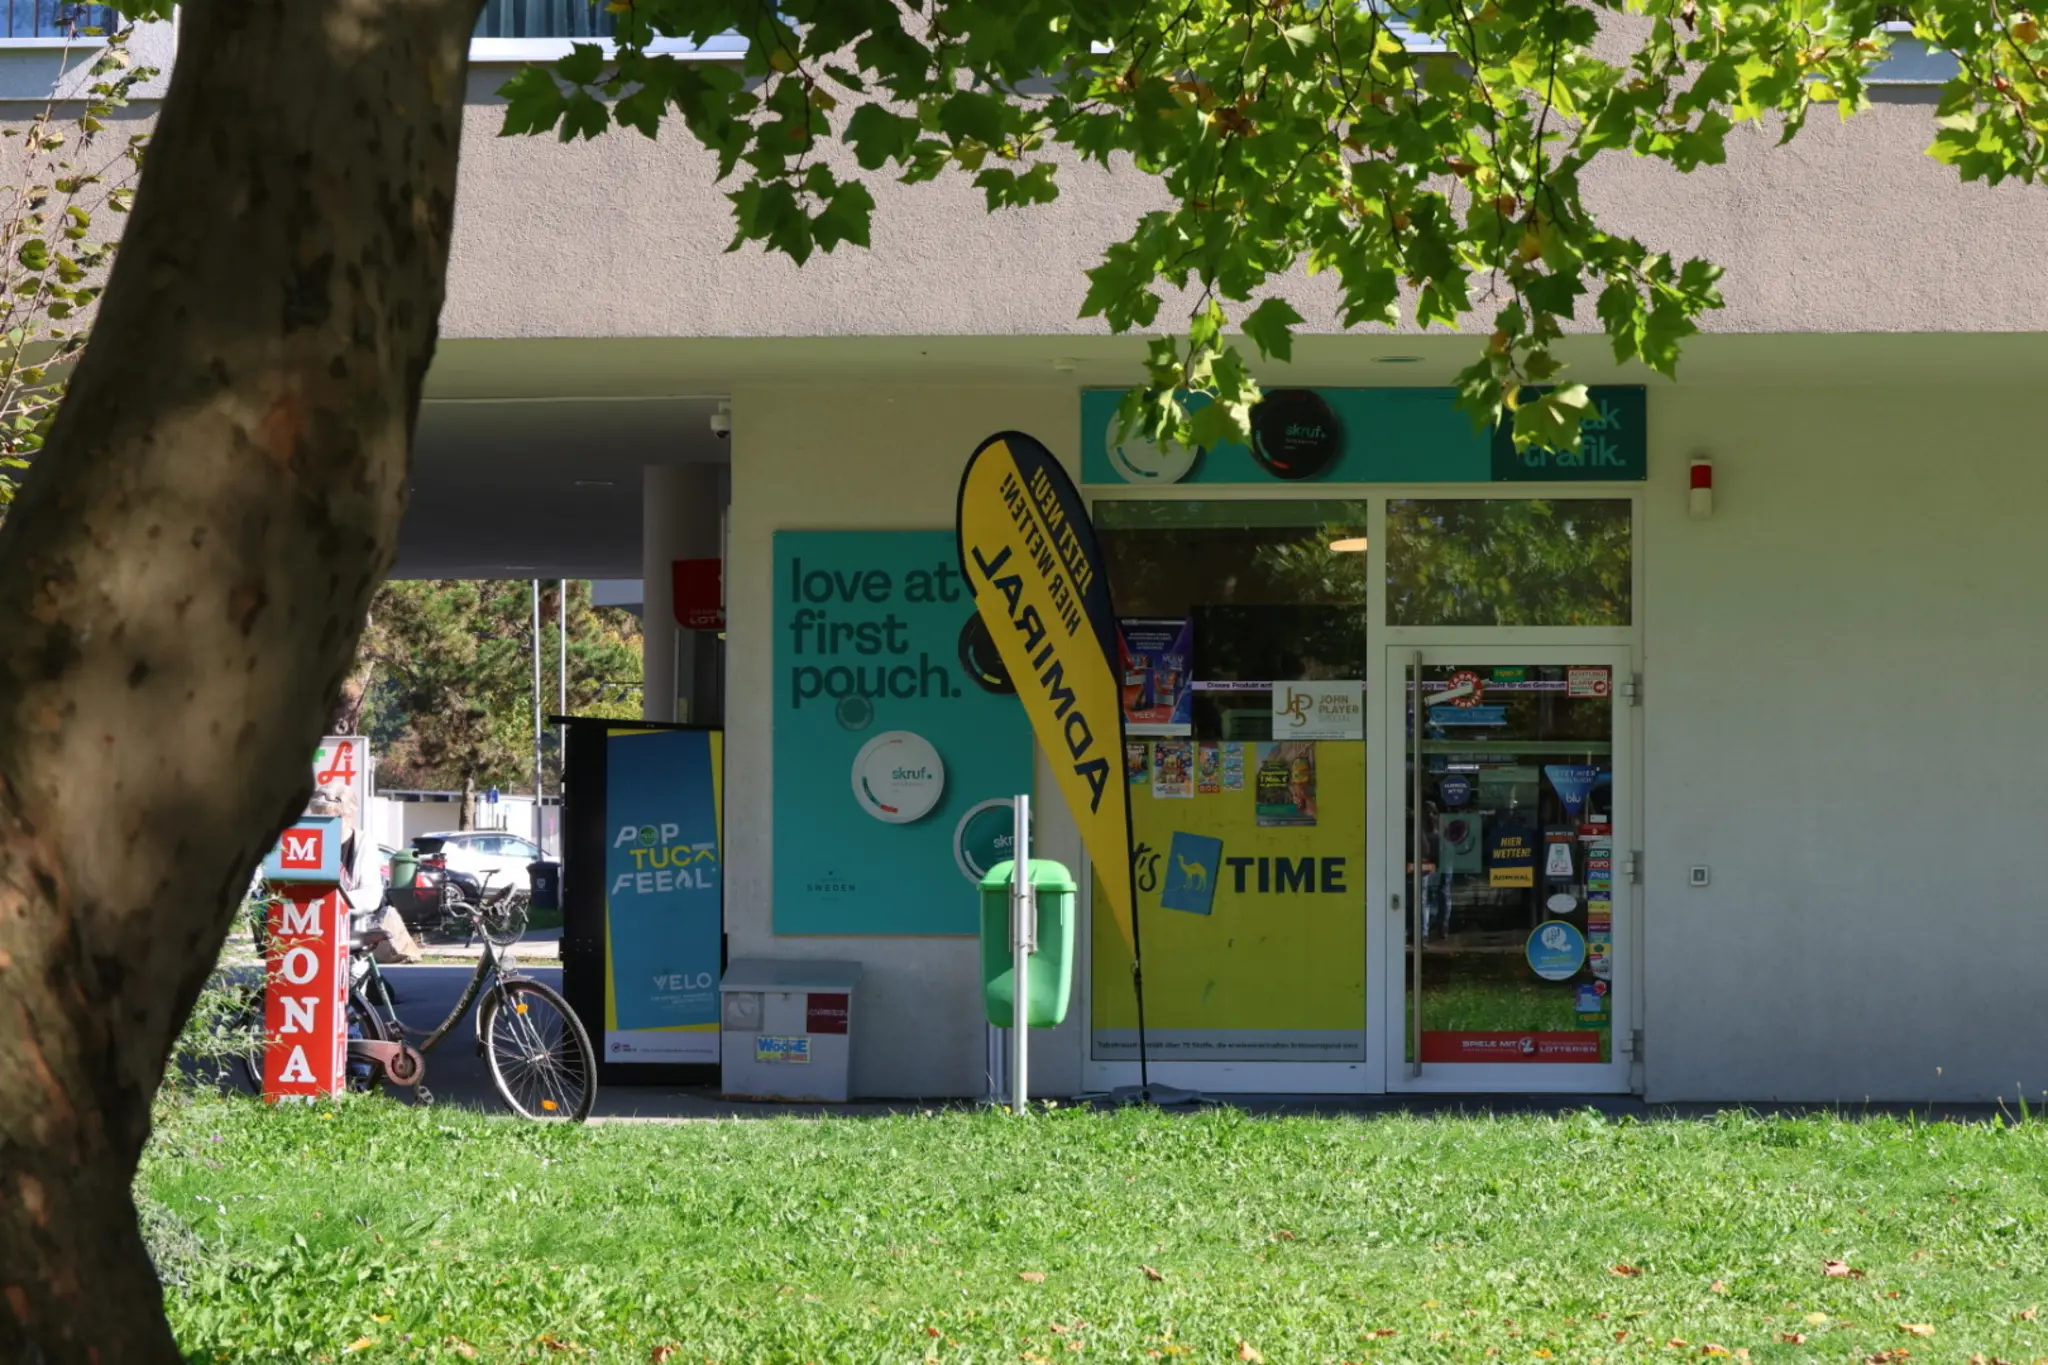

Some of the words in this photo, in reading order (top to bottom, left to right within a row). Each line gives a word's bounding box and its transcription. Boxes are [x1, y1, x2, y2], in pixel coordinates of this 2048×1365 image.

[791, 557, 893, 604] love
[904, 561, 960, 604] at
[790, 608, 909, 655] first
[792, 652, 962, 709] pouch.
[1319, 695, 1348, 704] JOHN
[1319, 705, 1359, 714] PLAYER
[1566, 792, 1581, 803] blu
[287, 837, 318, 861] M
[1500, 836, 1522, 847] HIER
[1225, 857, 1348, 894] TIME
[652, 972, 713, 991] VELO
